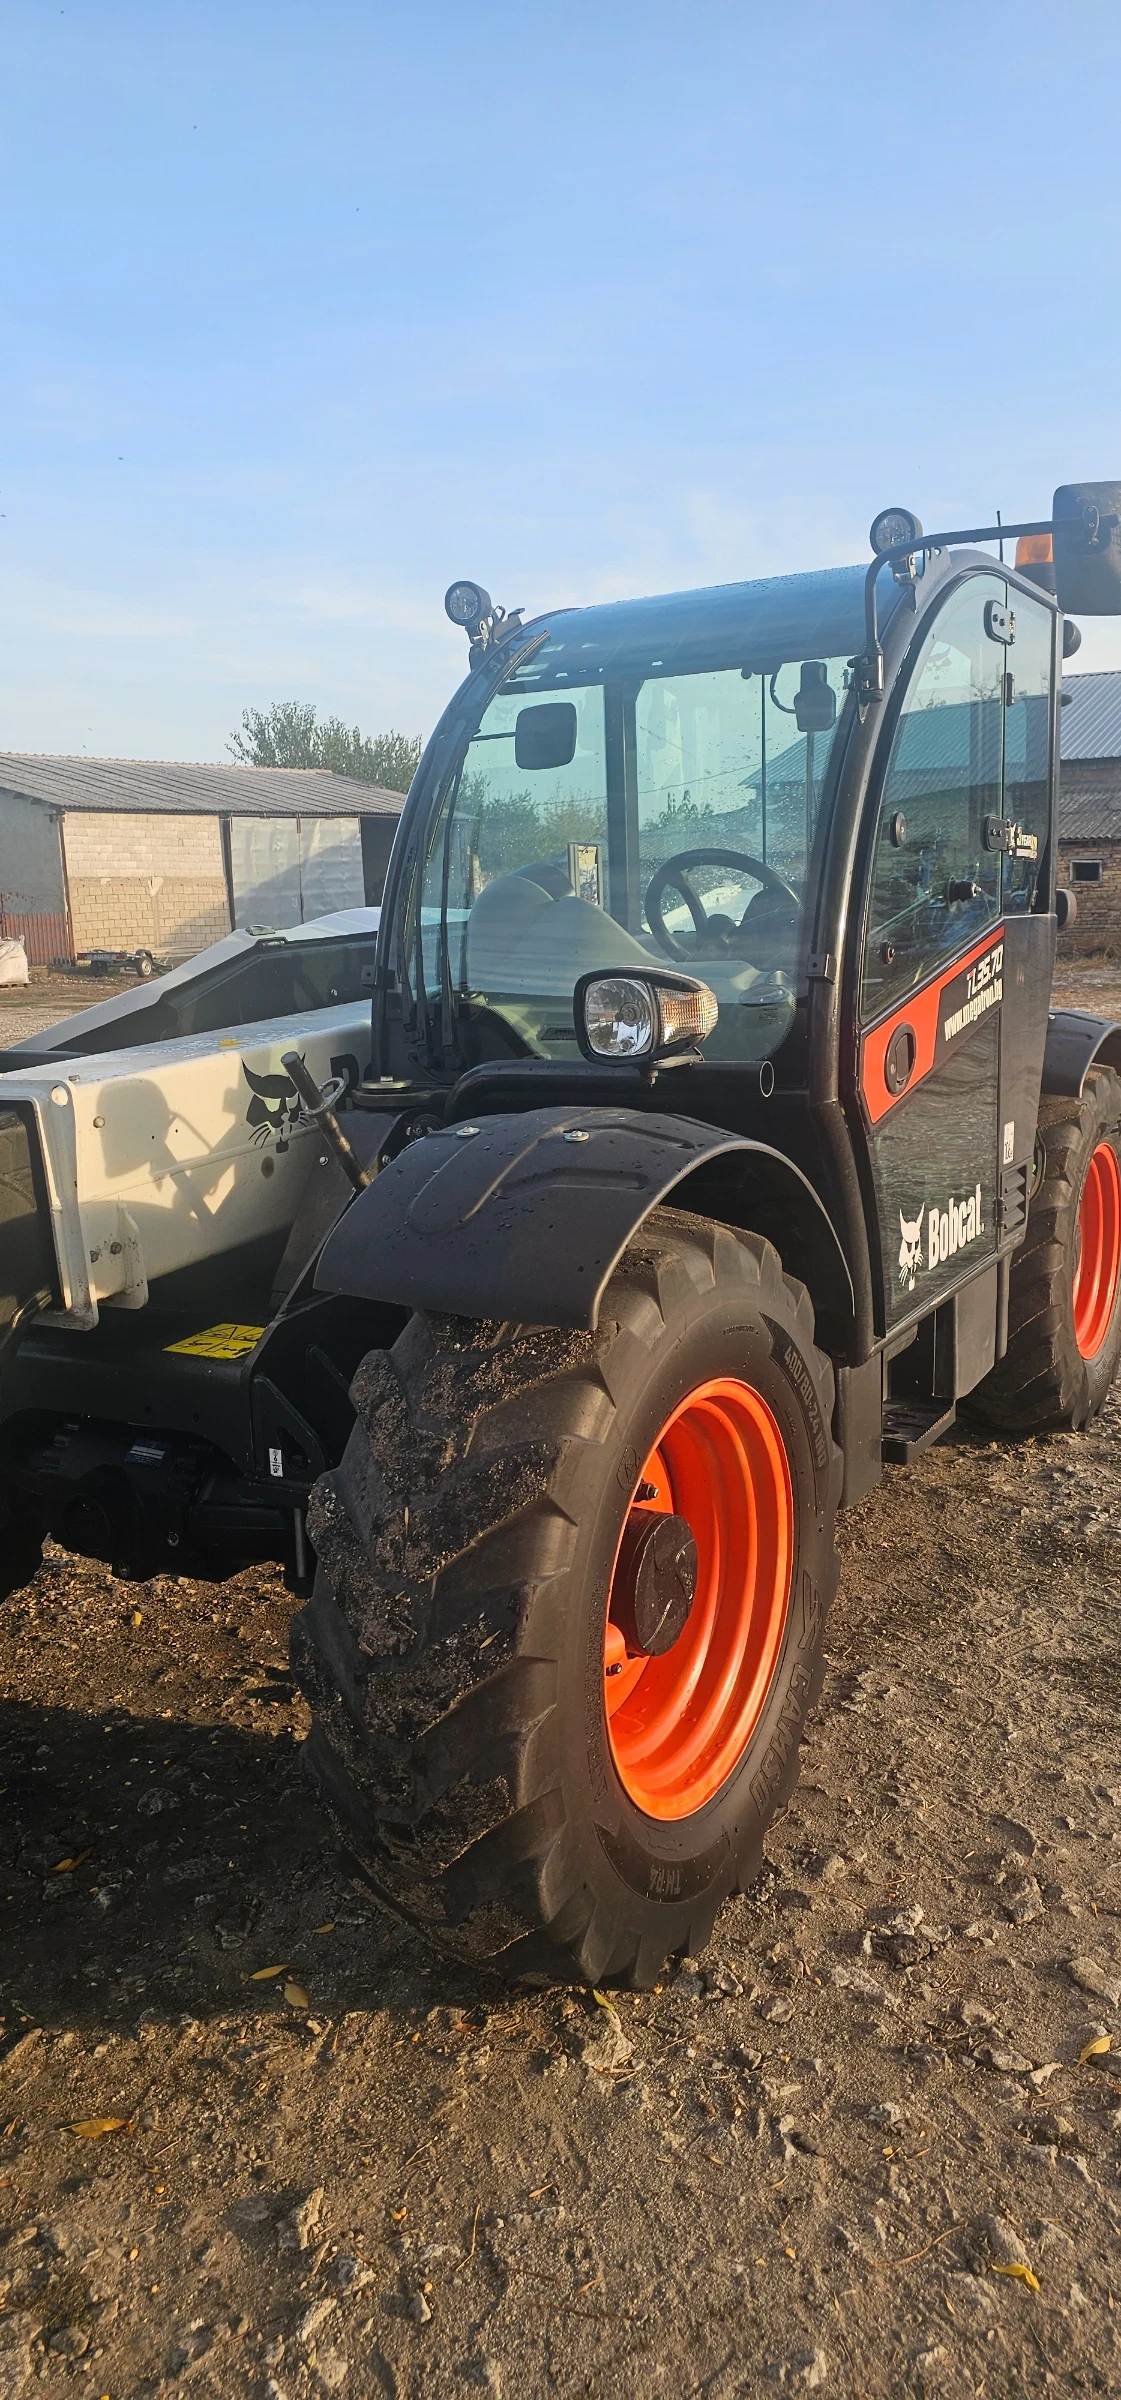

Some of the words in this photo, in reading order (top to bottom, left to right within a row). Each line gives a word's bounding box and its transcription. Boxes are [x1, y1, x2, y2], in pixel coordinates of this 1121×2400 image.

[966, 943, 1004, 1000] TL35.70
[944, 978, 1003, 1041] www.megatron.bg
[928, 1183, 982, 1271] Bobcat
[749, 1662, 812, 1817] CAMSO
